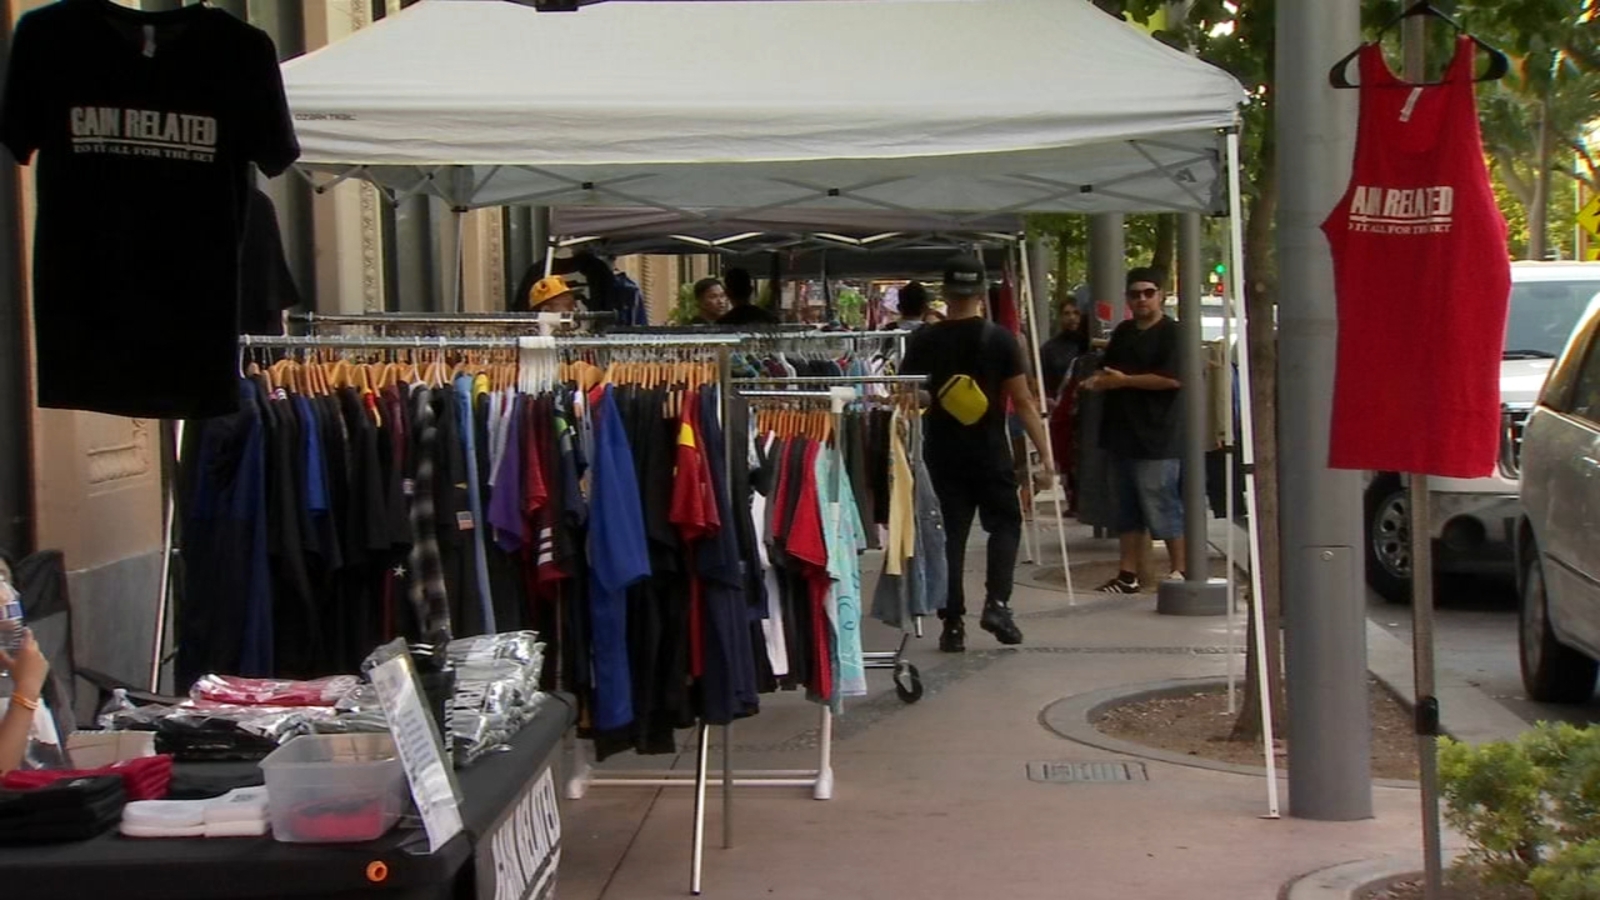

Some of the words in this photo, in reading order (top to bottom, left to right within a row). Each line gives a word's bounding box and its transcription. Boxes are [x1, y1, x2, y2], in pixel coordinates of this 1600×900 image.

[70, 106, 120, 137] GAIN
[124, 108, 218, 146] RELATED
[132, 145, 161, 158] FOR
[163, 149, 190, 161] THE
[1355, 223, 1368, 231] IT
[1387, 224, 1411, 234] FOR
